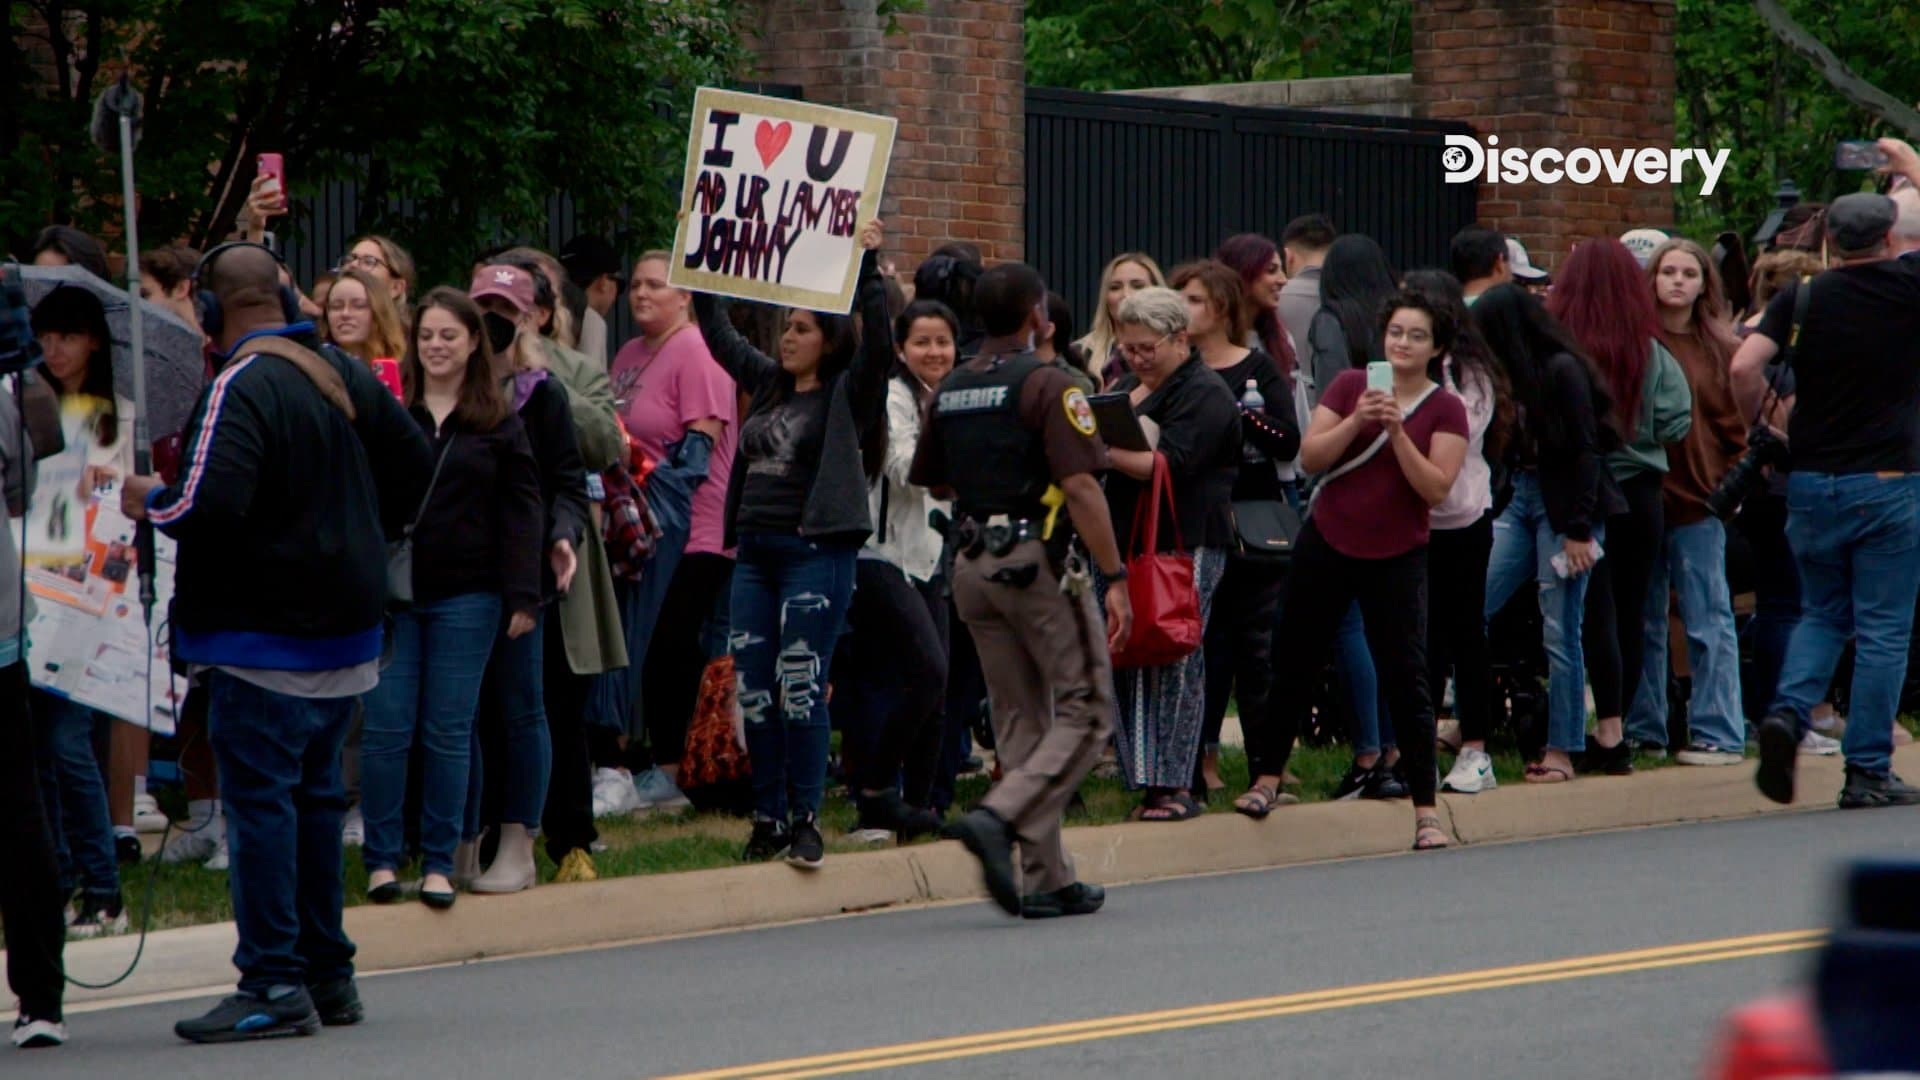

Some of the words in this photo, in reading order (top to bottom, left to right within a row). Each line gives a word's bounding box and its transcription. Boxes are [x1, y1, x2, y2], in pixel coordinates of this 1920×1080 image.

[703, 109, 740, 168] I
[806, 124, 854, 183] U
[691, 170, 727, 217] AND
[735, 173, 770, 223] UR
[684, 215, 802, 284] JOHNNY
[937, 385, 1009, 413] SHERIFF
